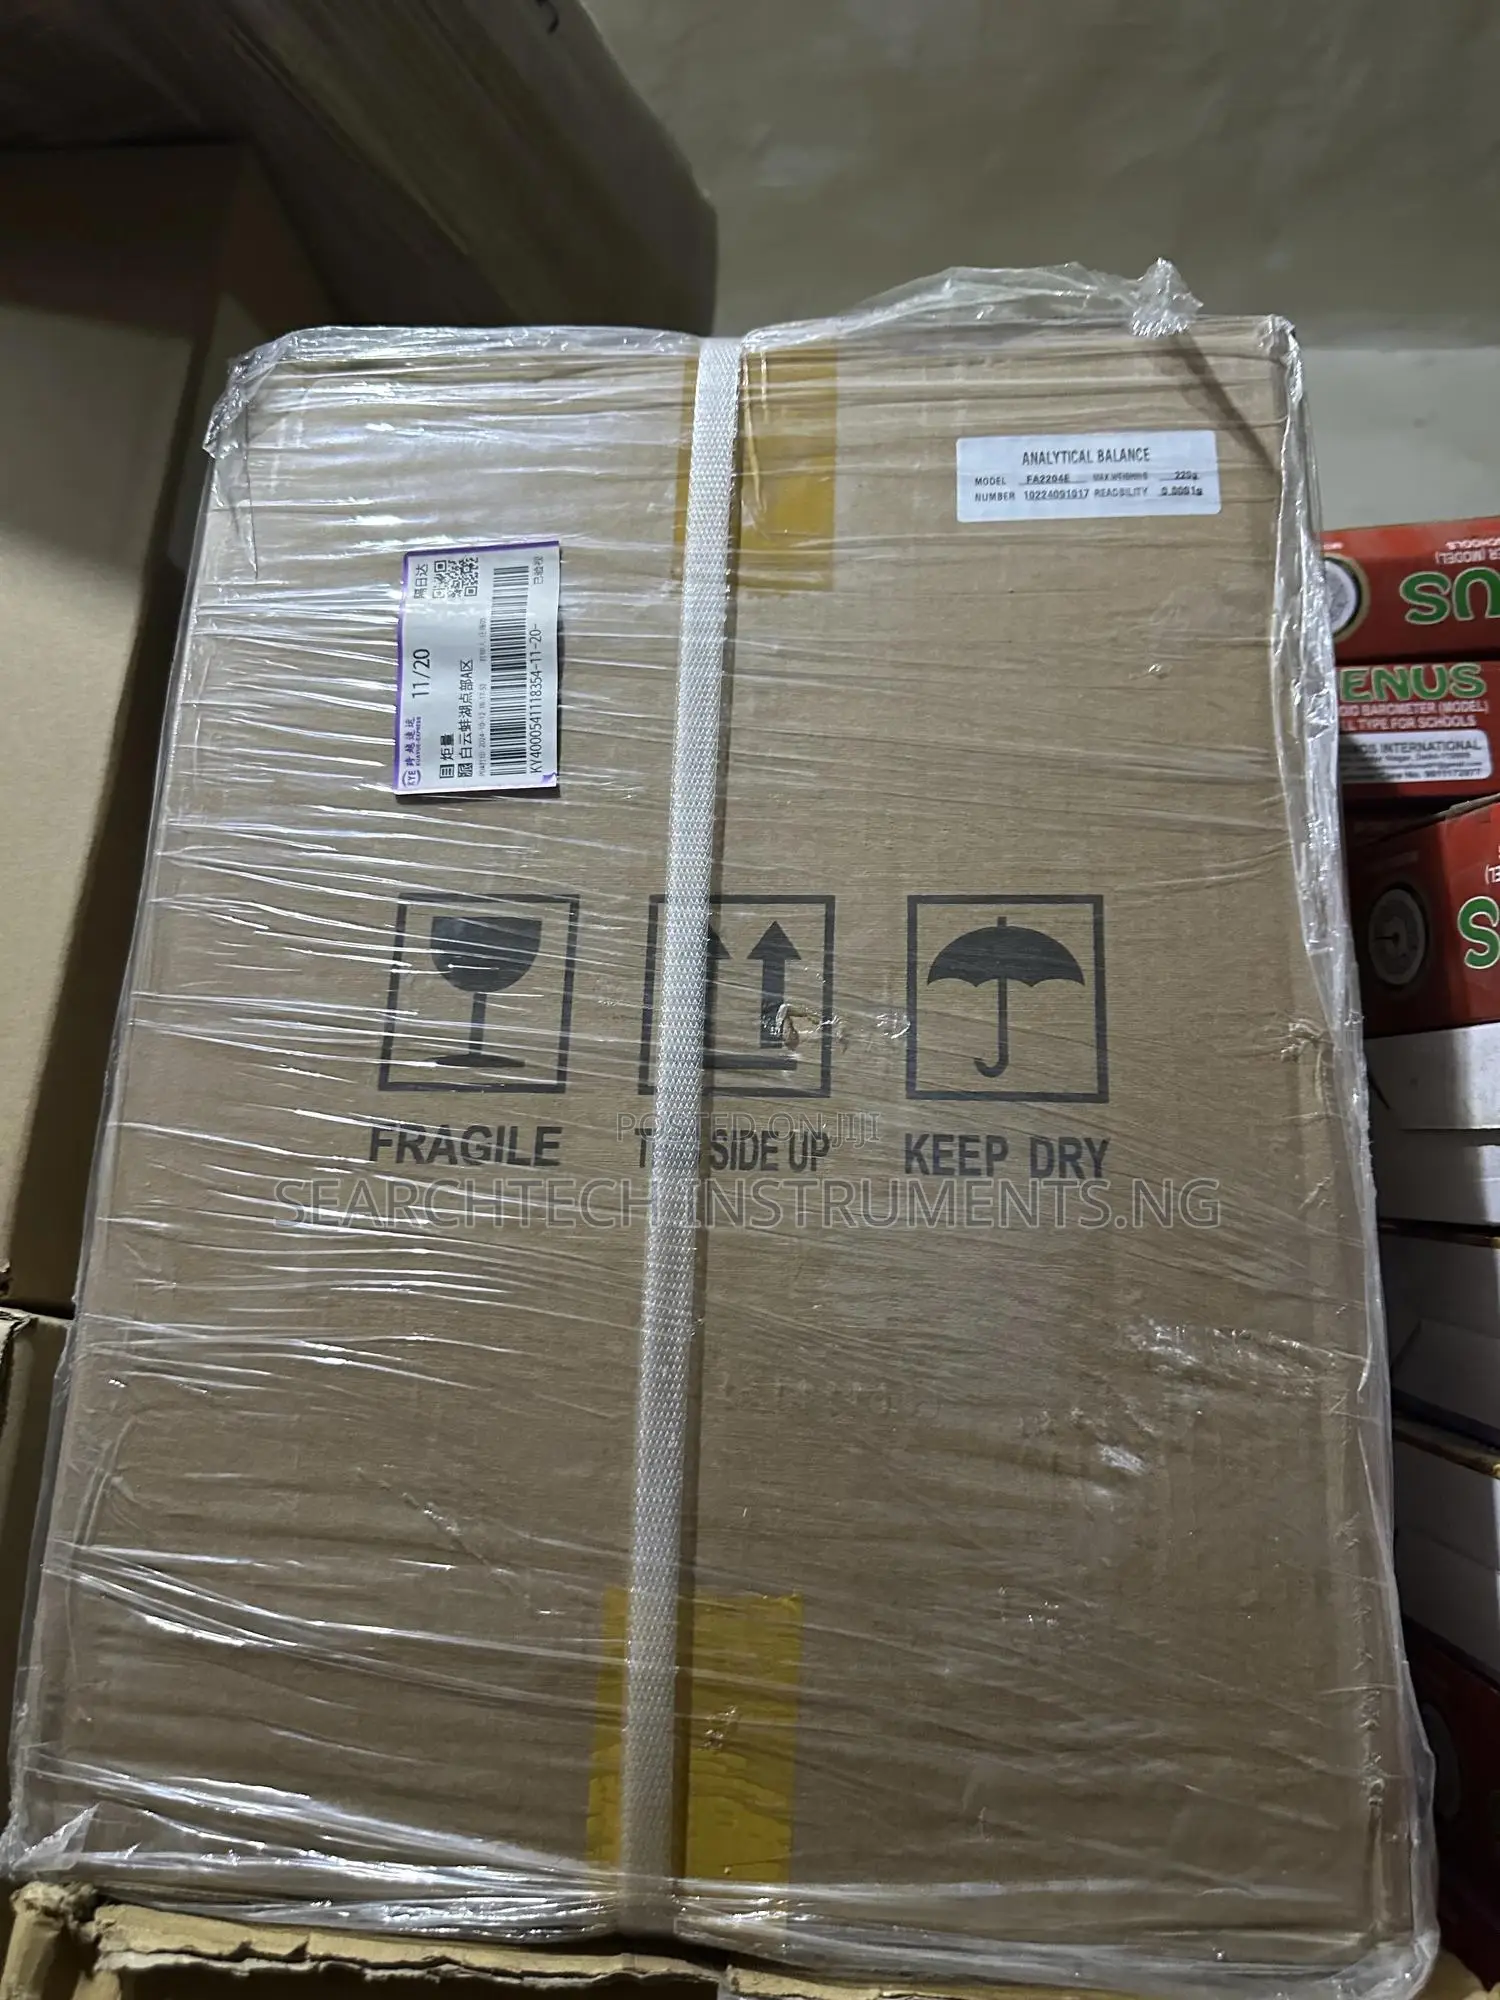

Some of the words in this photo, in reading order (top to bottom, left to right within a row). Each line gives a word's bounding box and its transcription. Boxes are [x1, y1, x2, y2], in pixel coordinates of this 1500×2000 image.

[1022, 450, 1093, 466] ANALYTICAL
[1097, 447, 1151, 463] BALANCE
[974, 476, 1007, 487] MODEL
[974, 491, 1016, 503] NUMBER
[1399, 566, 1500, 625] US
[412, 649, 432, 698] 11/20
[1340, 662, 1488, 702] ENUS
[527, 624, 542, 774] KY4000541118354-11-20-
[1380, 739, 1482, 754] INTERNATIONAL
[368, 1123, 564, 1167] FRAGILE
[709, 1128, 779, 1171] SIDE
[789, 1130, 830, 1172] UP
[905, 1132, 1009, 1177] KEEP
[1030, 1136, 1110, 1179] DRY
